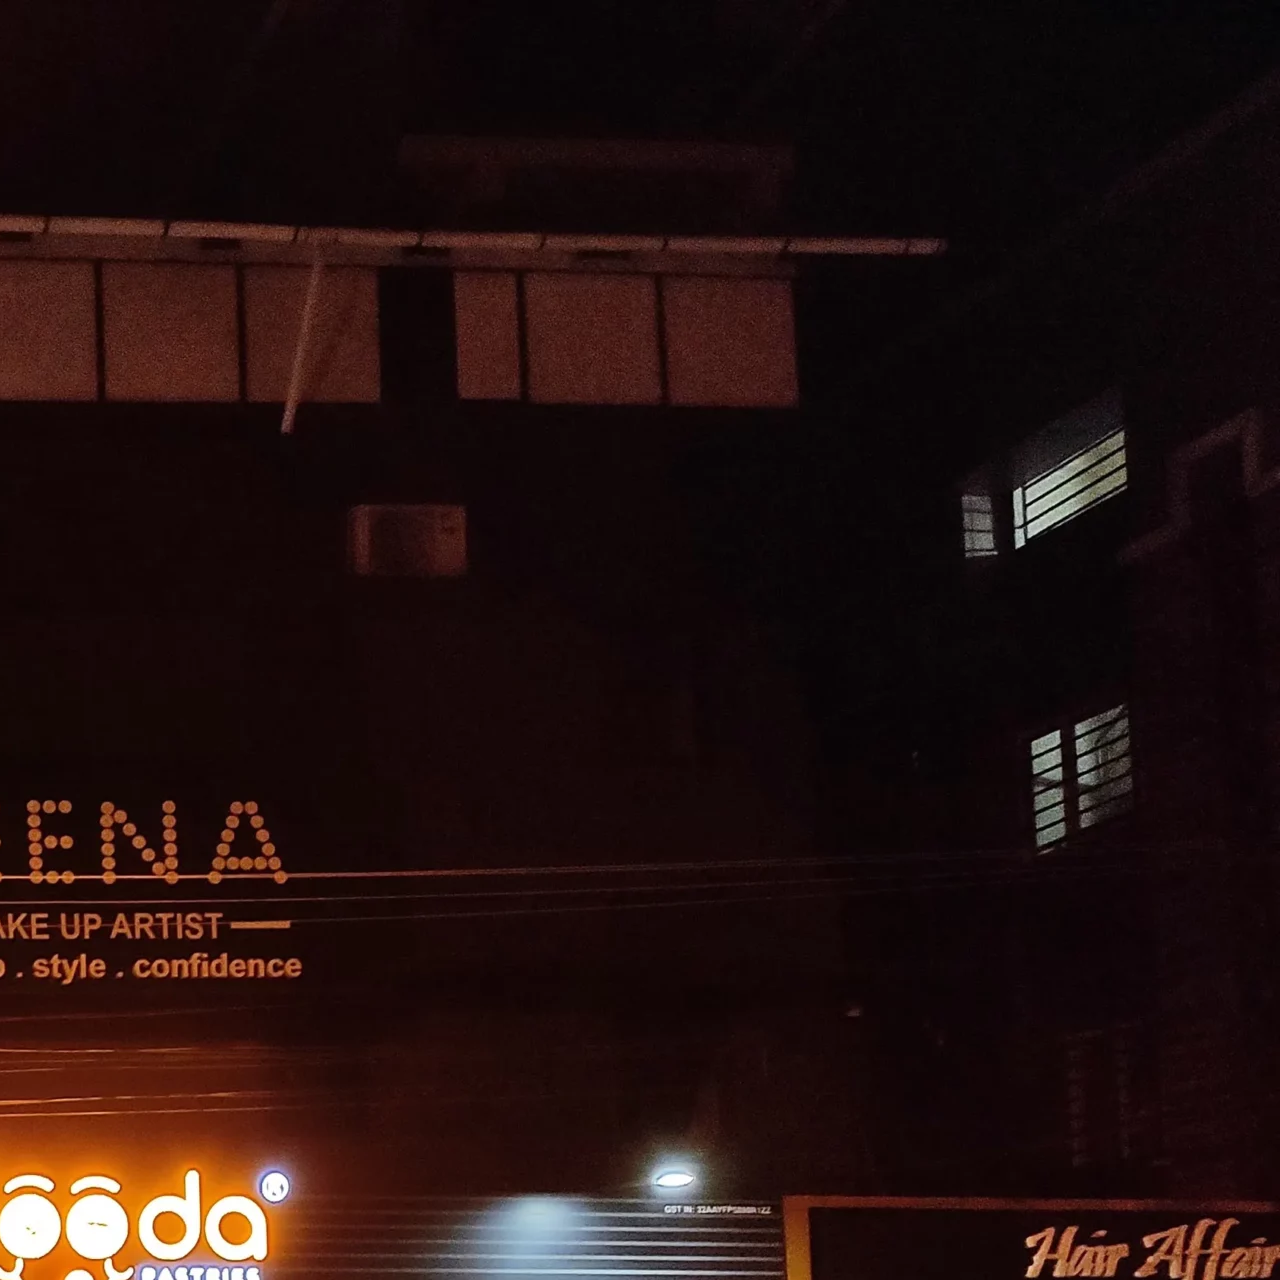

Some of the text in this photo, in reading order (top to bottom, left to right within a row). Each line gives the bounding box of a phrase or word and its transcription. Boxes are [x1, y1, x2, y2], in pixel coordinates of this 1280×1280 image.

[60, 912, 102, 939] UP
[110, 911, 224, 939] ARTIST
[33, 952, 106, 985] style
[133, 952, 303, 978] confidence
[1025, 1225, 1130, 1279] Hair
